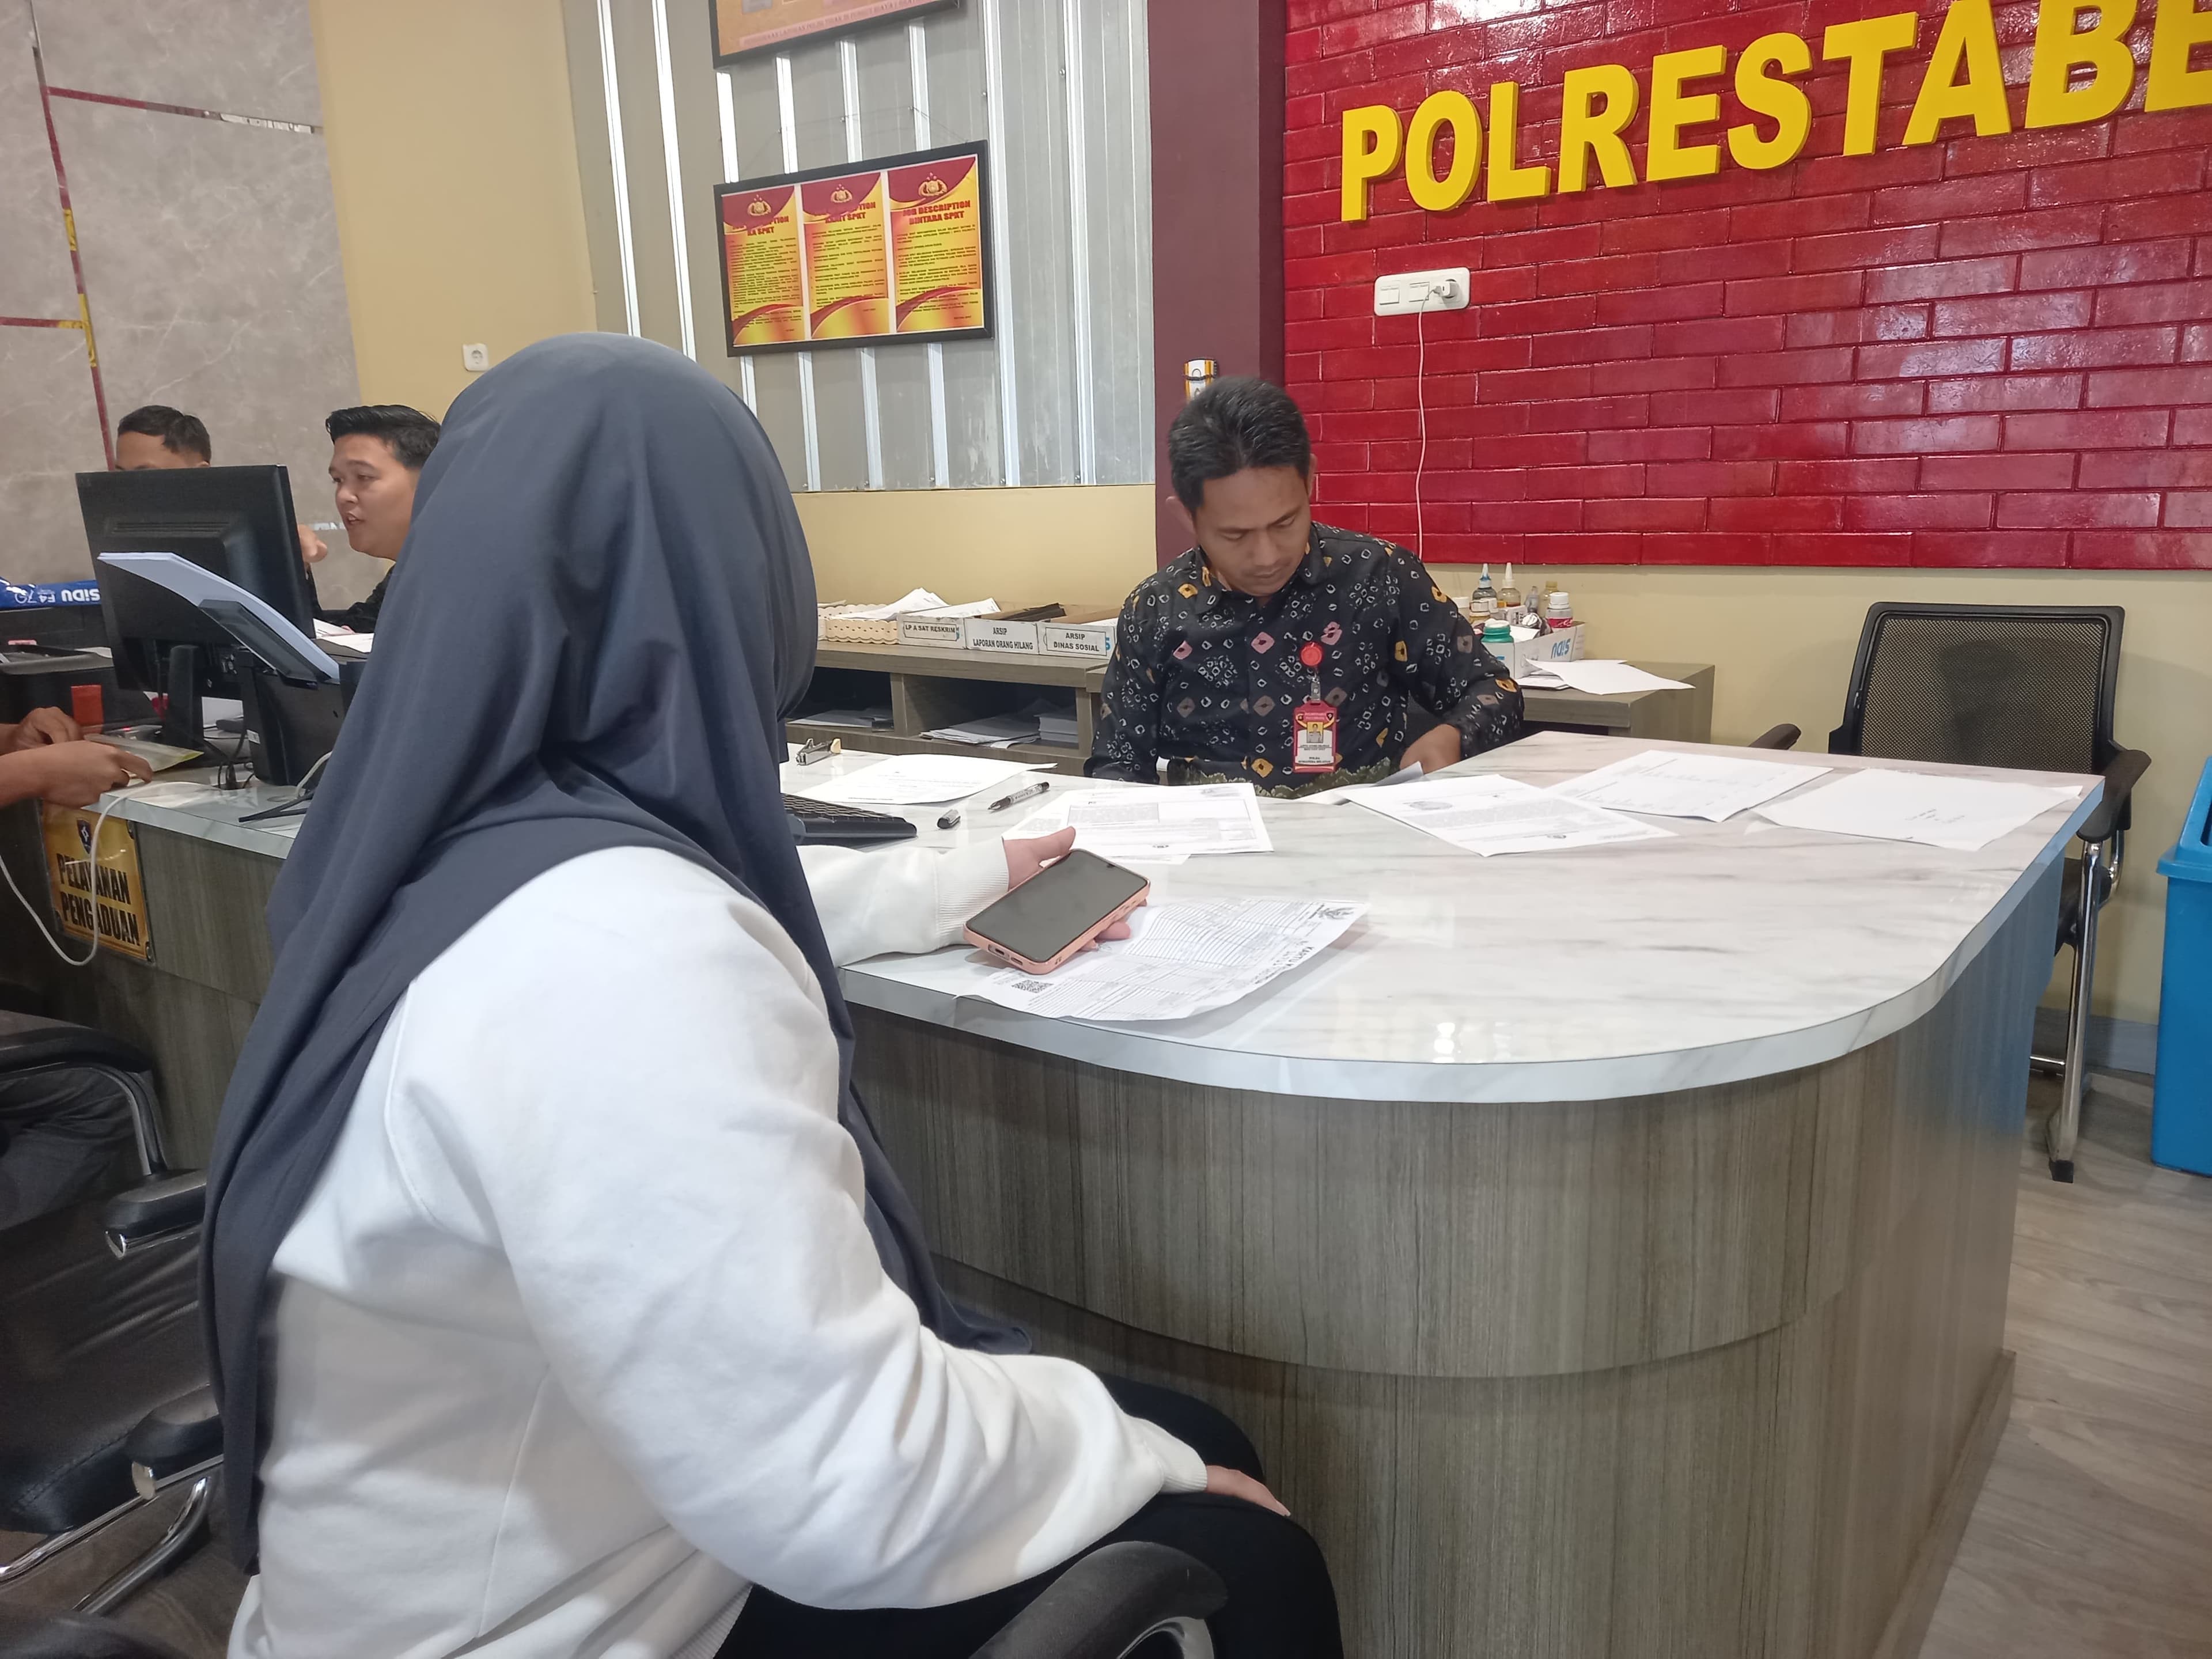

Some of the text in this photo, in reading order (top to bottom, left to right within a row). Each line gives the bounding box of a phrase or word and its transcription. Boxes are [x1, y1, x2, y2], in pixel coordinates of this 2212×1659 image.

[1341, 0, 2212, 222] POLRESTABE
[919, 200, 971, 214] DESCRIPTION
[993, 627, 1007, 635] ARSIP
[973, 638, 1033, 650] LAPORAN ORANG HILANG
[1054, 641, 1074, 649] DINAS
[60, 891, 141, 946] PENGADUAN
